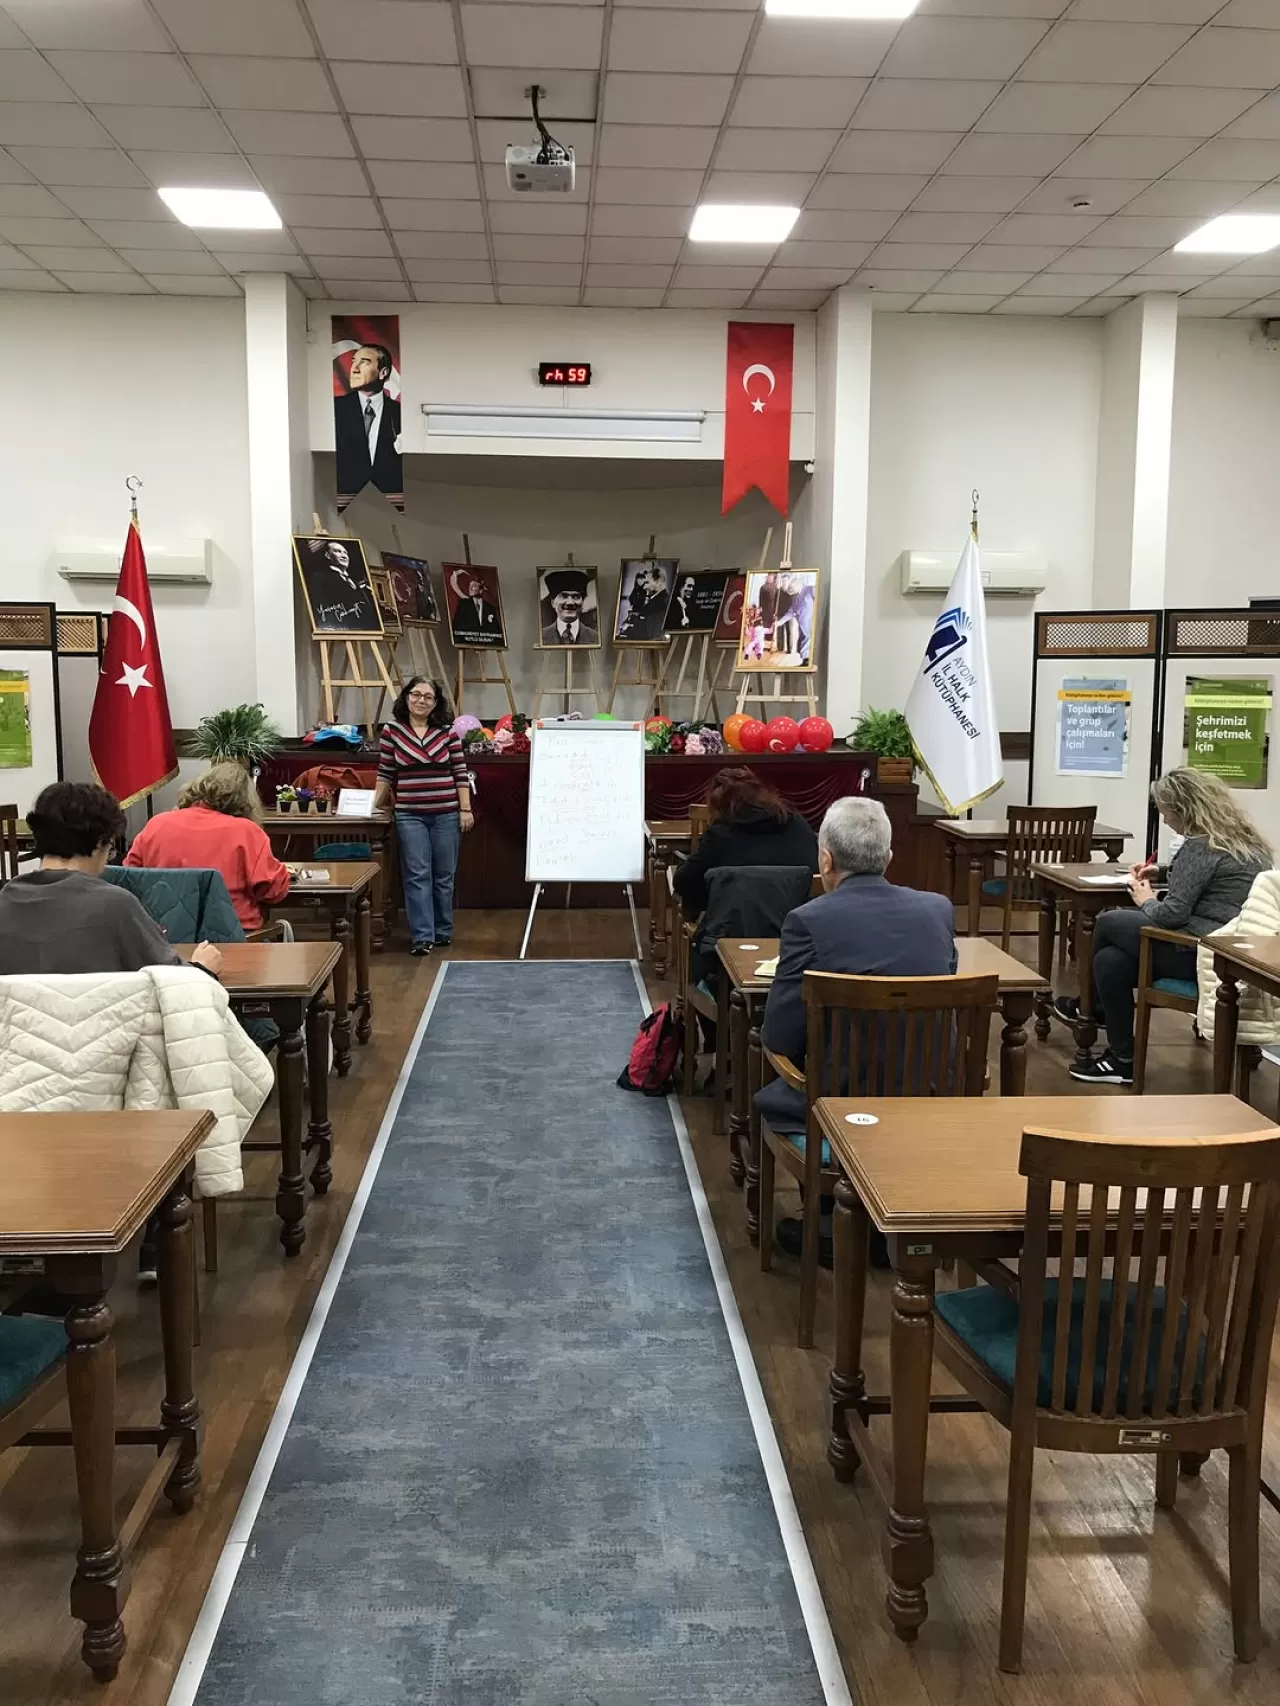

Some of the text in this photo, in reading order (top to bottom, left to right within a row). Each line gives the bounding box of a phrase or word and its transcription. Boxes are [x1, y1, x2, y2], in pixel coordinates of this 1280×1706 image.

[568, 368, 587, 381] 59
[953, 657, 977, 686] AYDIN
[942, 662, 971, 703] İL HALK
[931, 672, 981, 739] KÜTÜPHANESİ
[1067, 704, 1117, 715] Toplantılar
[1079, 718, 1101, 727] grup
[1196, 715, 1247, 727] Şehrimizi
[1066, 728, 1115, 738] çalışmaları
[1195, 728, 1252, 740] keşfetmek
[1195, 742, 1214, 753] için
